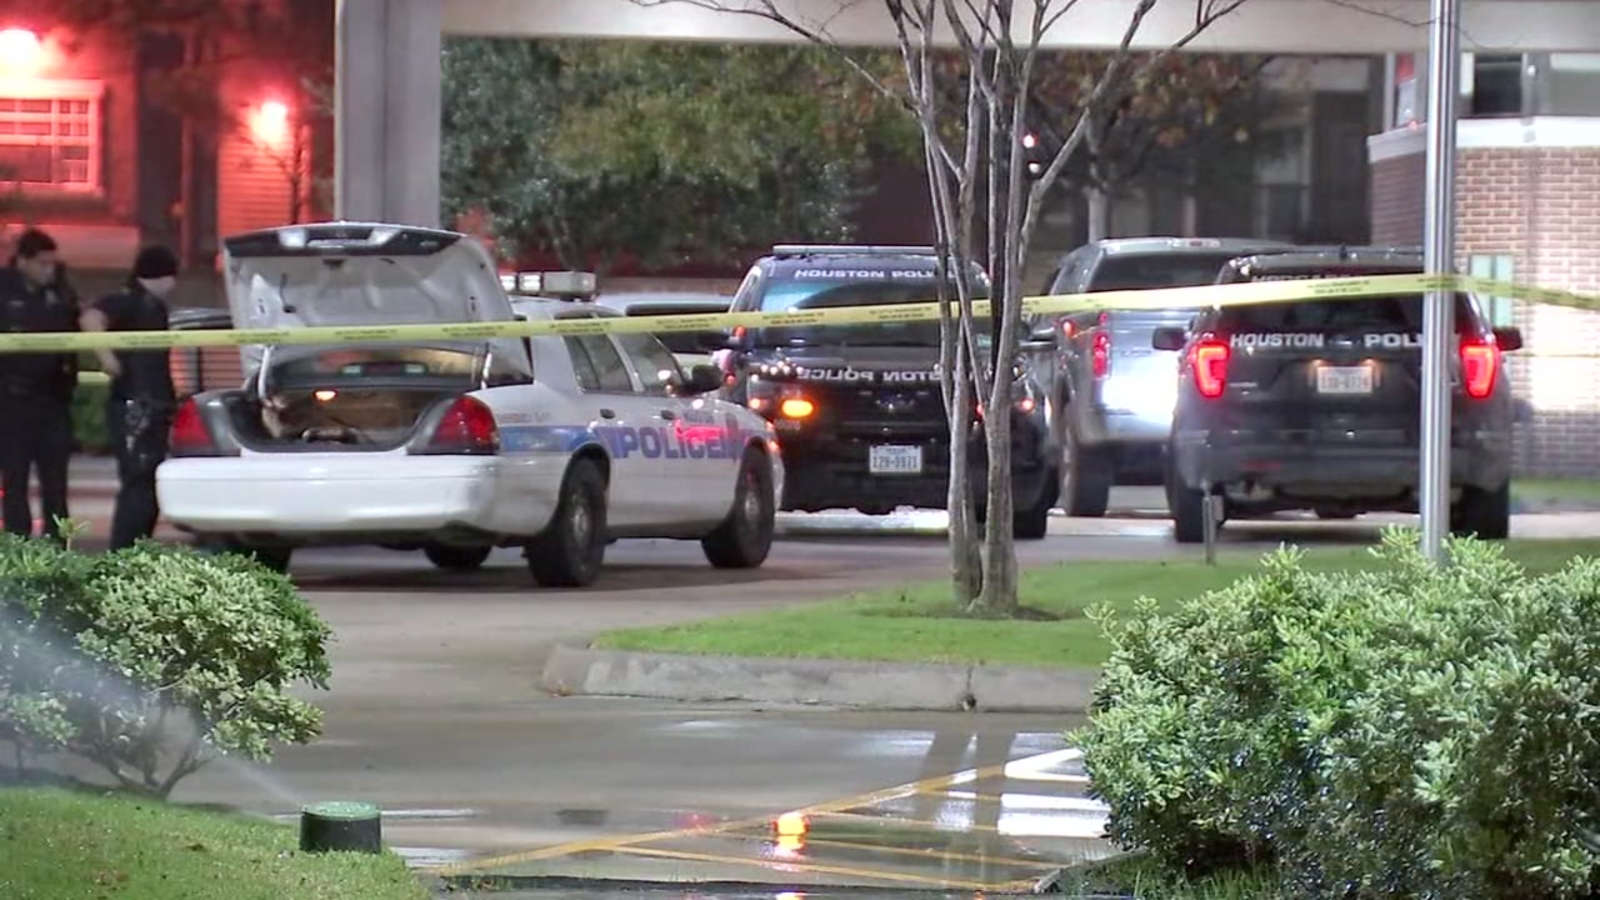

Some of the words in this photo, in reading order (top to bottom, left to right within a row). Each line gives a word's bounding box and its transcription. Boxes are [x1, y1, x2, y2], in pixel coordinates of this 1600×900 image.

[794, 269, 885, 278] HOUSTON
[1229, 333, 1324, 347] HOUSTON
[1364, 333, 1424, 347] POLI
[612, 426, 724, 459] POLICE
